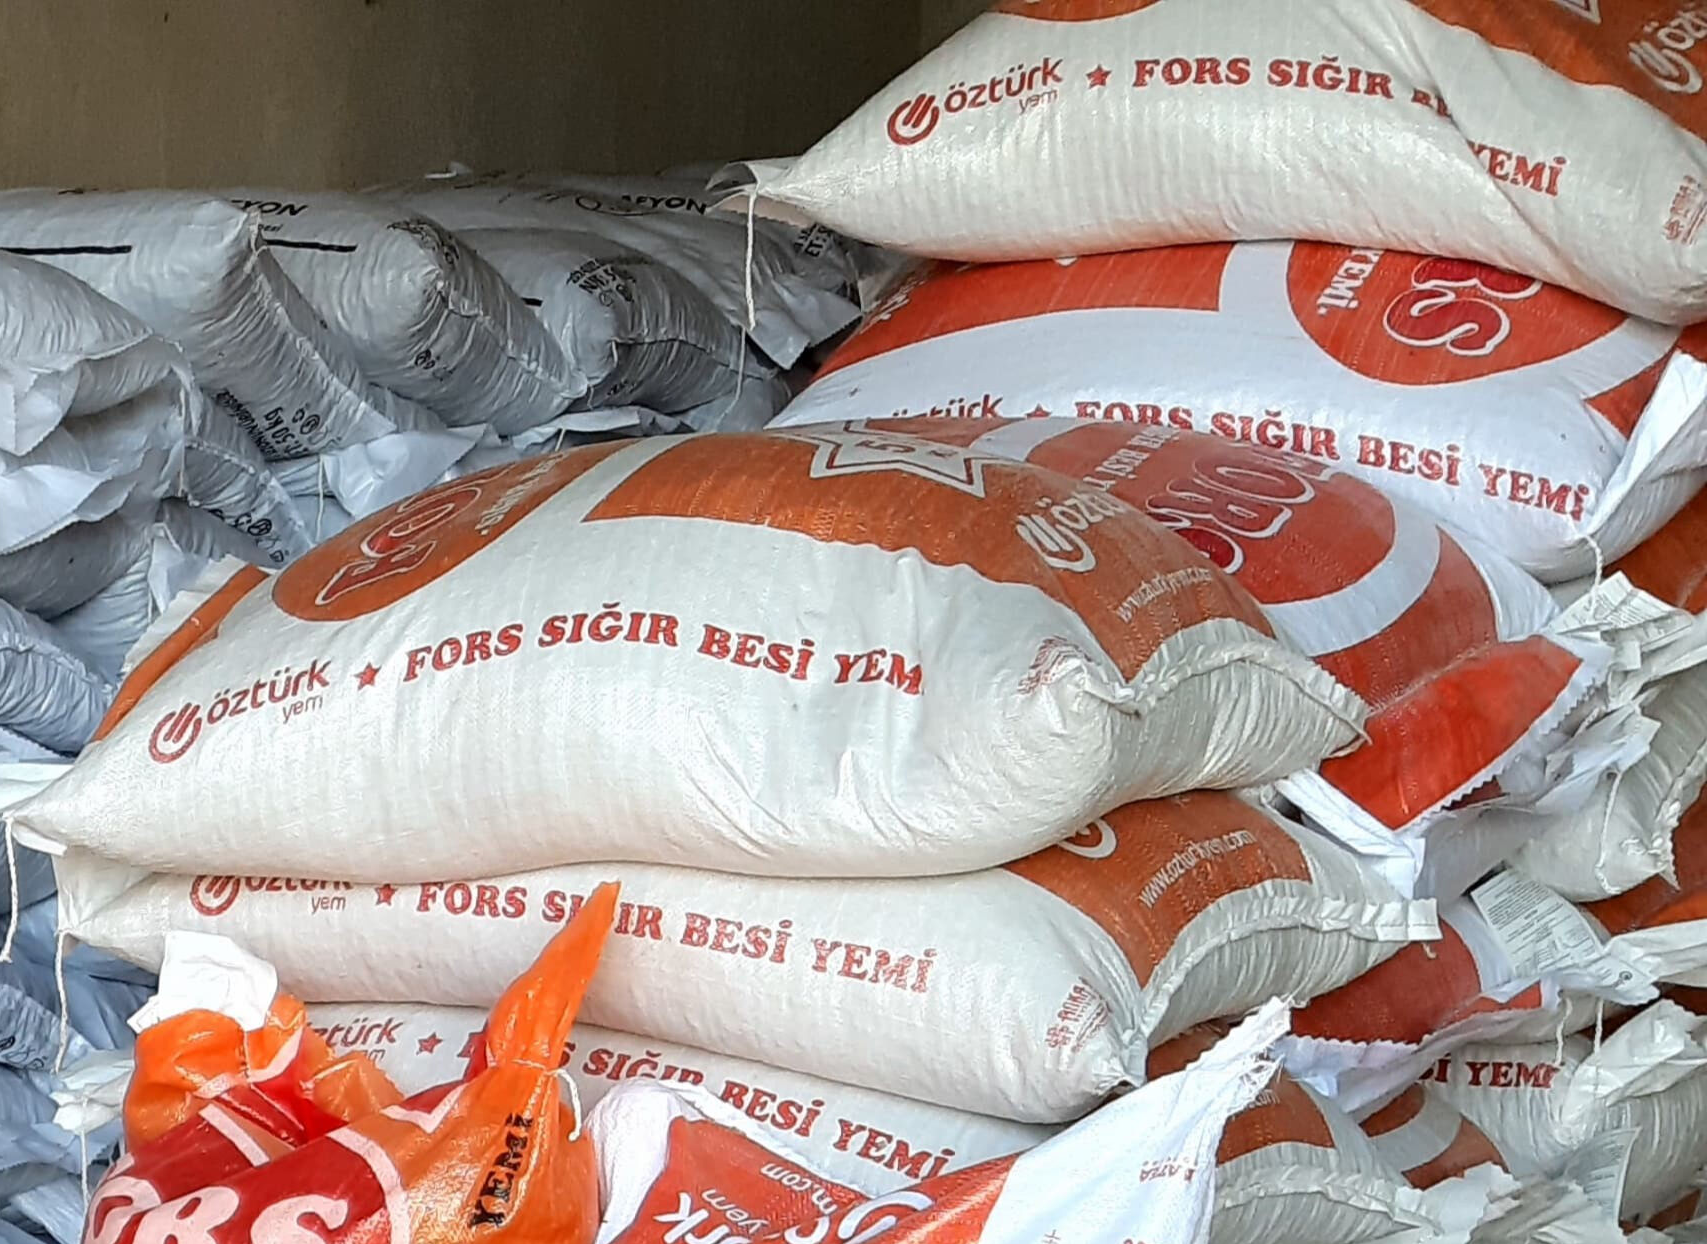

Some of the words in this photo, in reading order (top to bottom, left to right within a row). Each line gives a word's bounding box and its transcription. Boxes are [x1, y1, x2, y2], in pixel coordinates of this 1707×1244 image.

[944, 57, 1063, 116] öztürk
[1133, 57, 1250, 89] FORS
[1266, 55, 1393, 100] SIĞIR
[1017, 89, 1059, 116] yem
[1211, 410, 1339, 461] SIĞIR
[1356, 433, 1462, 487] BESİ
[1476, 464, 1592, 524] YEMİ
[207, 656, 330, 726] öztürk
[404, 623, 522, 686] FORS
[537, 600, 678, 649] SIĞIR
[699, 623, 813, 683] BESİ
[832, 647, 925, 698] YEM
[281, 693, 324, 726] yem
[312, 893, 347, 916] yem
[417, 881, 527, 922] FORS
[542, 889, 664, 943] SIIR
[684, 912, 793, 966] BESİ
[810, 936, 940, 994] YEMİ
[721, 1077, 823, 1139] BESİ
[839, 1119, 951, 1181] YEMİ
